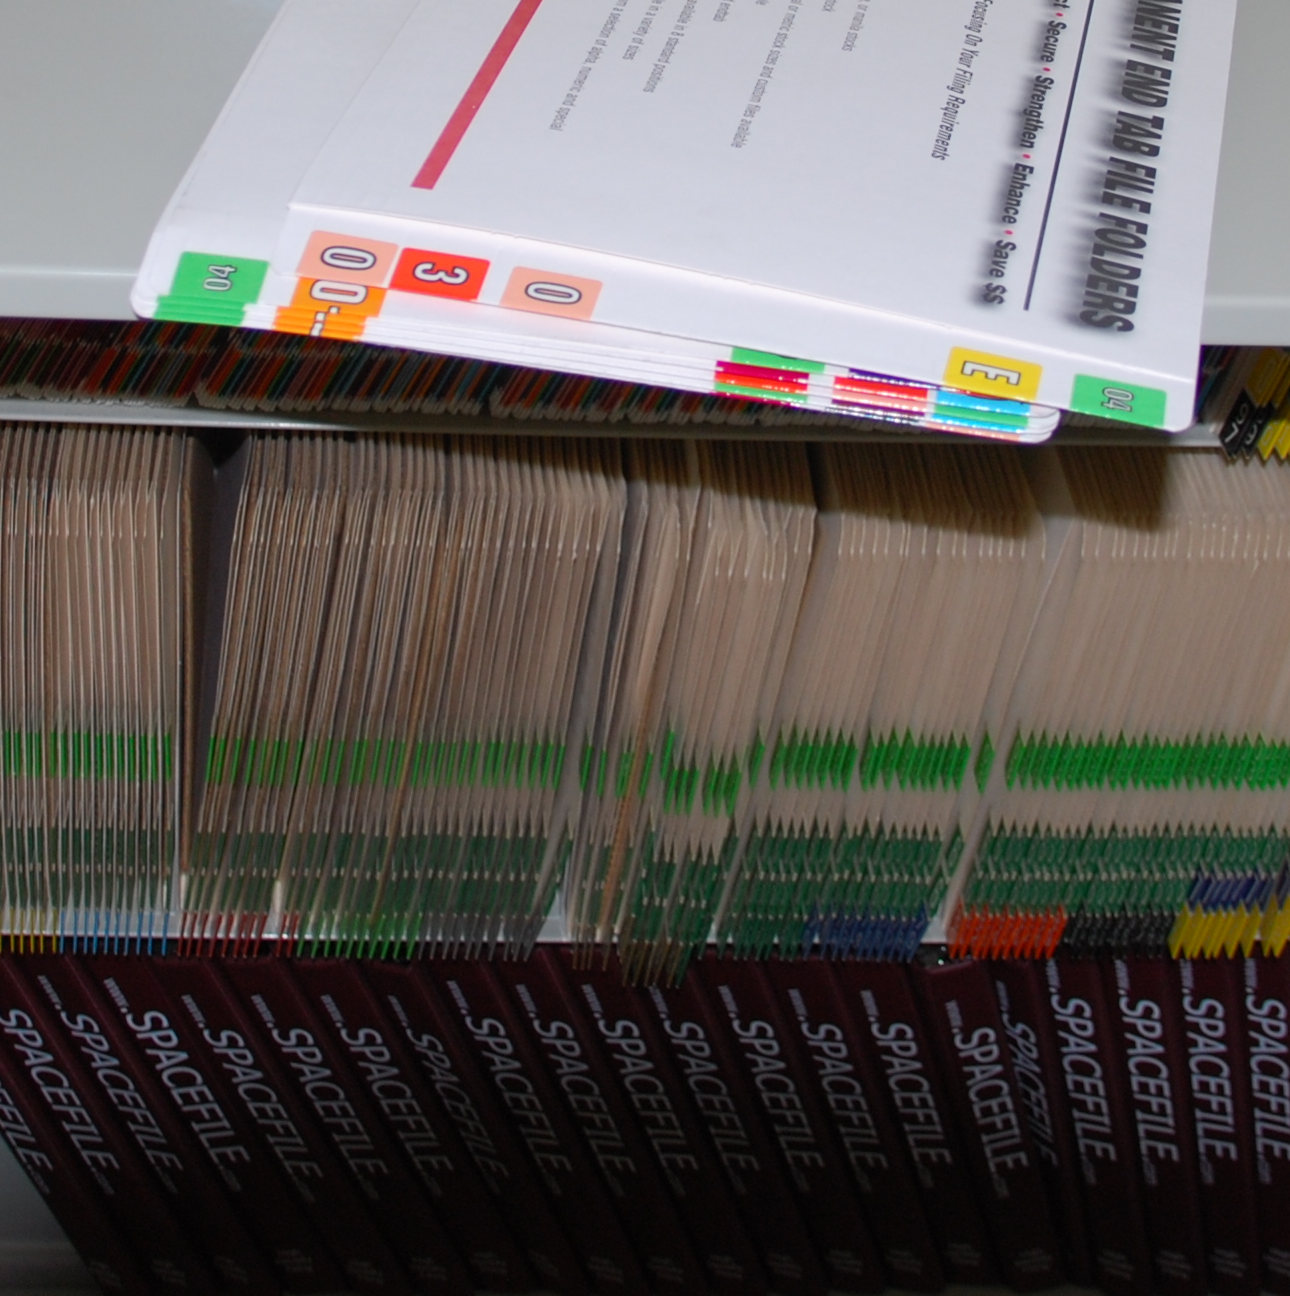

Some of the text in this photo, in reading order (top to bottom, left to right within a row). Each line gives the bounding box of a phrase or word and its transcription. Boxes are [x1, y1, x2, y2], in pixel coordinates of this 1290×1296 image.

[963, 33, 984, 47] On
[1039, 20, 1067, 63] Secure
[957, 47, 980, 69] Your
[946, 67, 974, 95] Filing
[1120, 59, 1172, 108] END
[1018, 75, 1055, 149] Strengthen
[930, 94, 966, 161] Requirements
[1109, 110, 1165, 157] TAB
[1001, 162, 1034, 224] Enhance
[1100, 156, 1157, 214] FILE
[320, 245, 378, 271] 0
[412, 260, 470, 285] 3
[988, 239, 1017, 278] Save
[1078, 212, 1149, 332] FOLDERS
[202, 263, 238, 292] 04
[524, 280, 583, 306] 0
[980, 282, 1007, 305] $$
[959, 360, 1021, 386] E
[1099, 387, 1137, 412] 04
